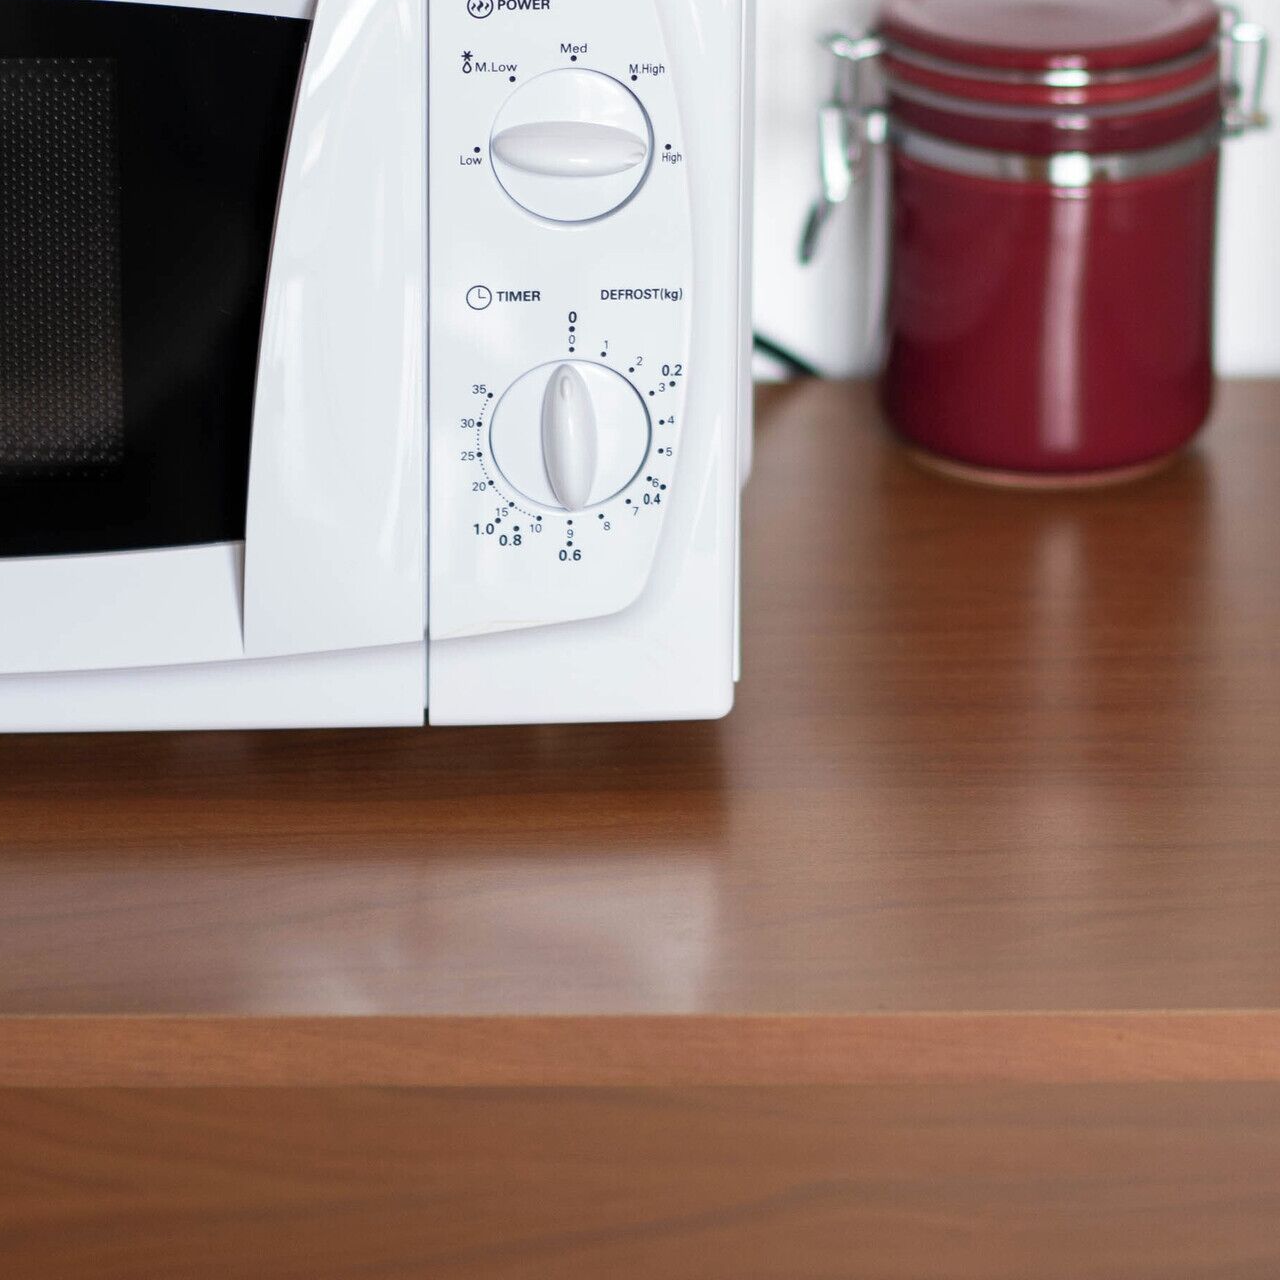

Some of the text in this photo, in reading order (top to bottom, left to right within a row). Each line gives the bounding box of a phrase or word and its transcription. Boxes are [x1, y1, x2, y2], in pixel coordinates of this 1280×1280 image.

[560, 43, 588, 54] Med
[475, 62, 518, 73] M.Low
[628, 63, 665, 76] M.High
[459, 155, 483, 166] Low
[661, 151, 683, 164] High
[496, 291, 541, 302] TIMER
[600, 288, 683, 301] DEFROST(kg)
[568, 311, 578, 324] 0
[568, 334, 576, 345] 0
[636, 356, 643, 366] 2
[661, 364, 683, 377] 0.2
[472, 384, 487, 395] 35
[658, 382, 666, 393] 3
[460, 418, 475, 429] 30
[667, 416, 675, 425] 4
[460, 451, 475, 461] 25
[665, 447, 673, 457] 5
[472, 482, 486, 492] 20
[651, 478, 659, 488] 6
[643, 493, 661, 505] 0.4
[496, 507, 509, 517] 15
[632, 506, 639, 516] 7
[473, 523, 495, 535] 1.0
[530, 524, 542, 533] 10
[603, 521, 611, 531] 8
[566, 529, 574, 539] 9
[499, 534, 522, 546] 0.8
[558, 549, 582, 561] 0.6
